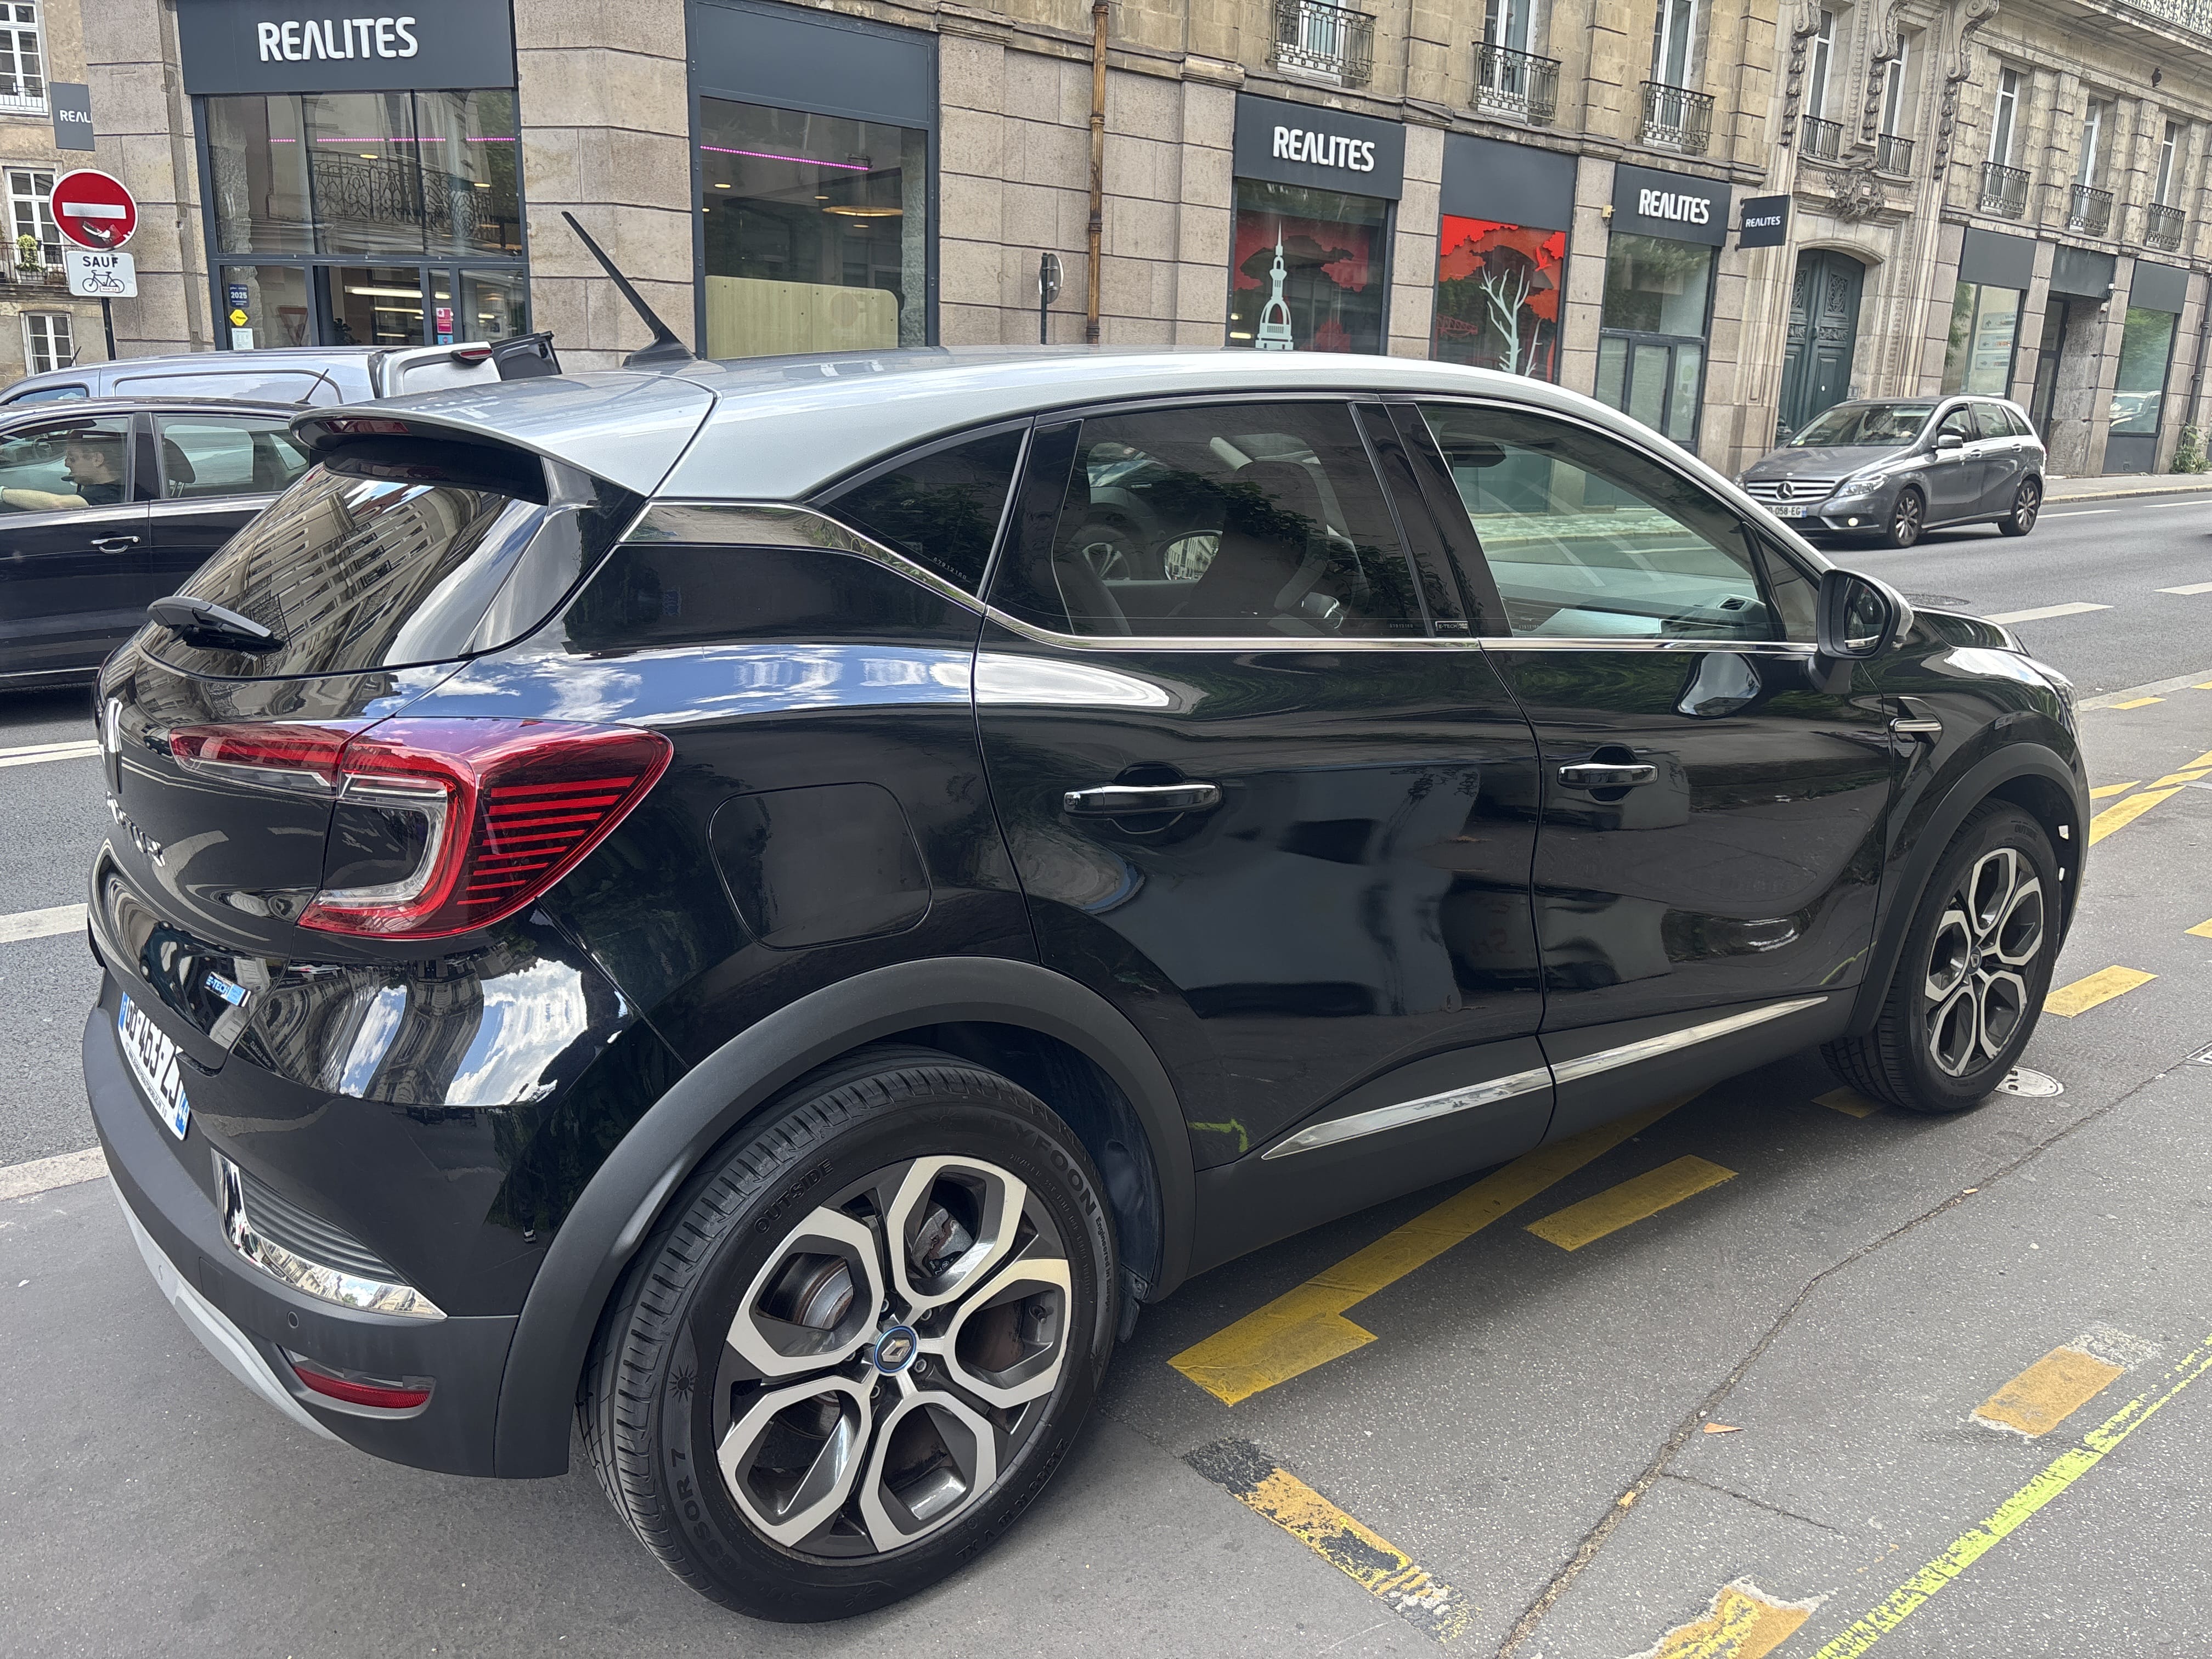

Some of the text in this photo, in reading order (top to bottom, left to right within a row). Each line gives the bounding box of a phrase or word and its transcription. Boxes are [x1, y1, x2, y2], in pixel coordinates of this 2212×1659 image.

[257, 16, 418, 62] REALITES
[1273, 126, 1375, 172] REALITES
[1638, 189, 1711, 224] REALITES
[1745, 216, 1781, 228] REALITES
[82, 256, 119, 268] SAUF
[989, 1114, 1096, 1217] TYFOON
[754, 1158, 834, 1234] OUTSIDE
[1096, 1216, 1110, 1267] Engineered
[671, 1447, 686, 1468] 7
